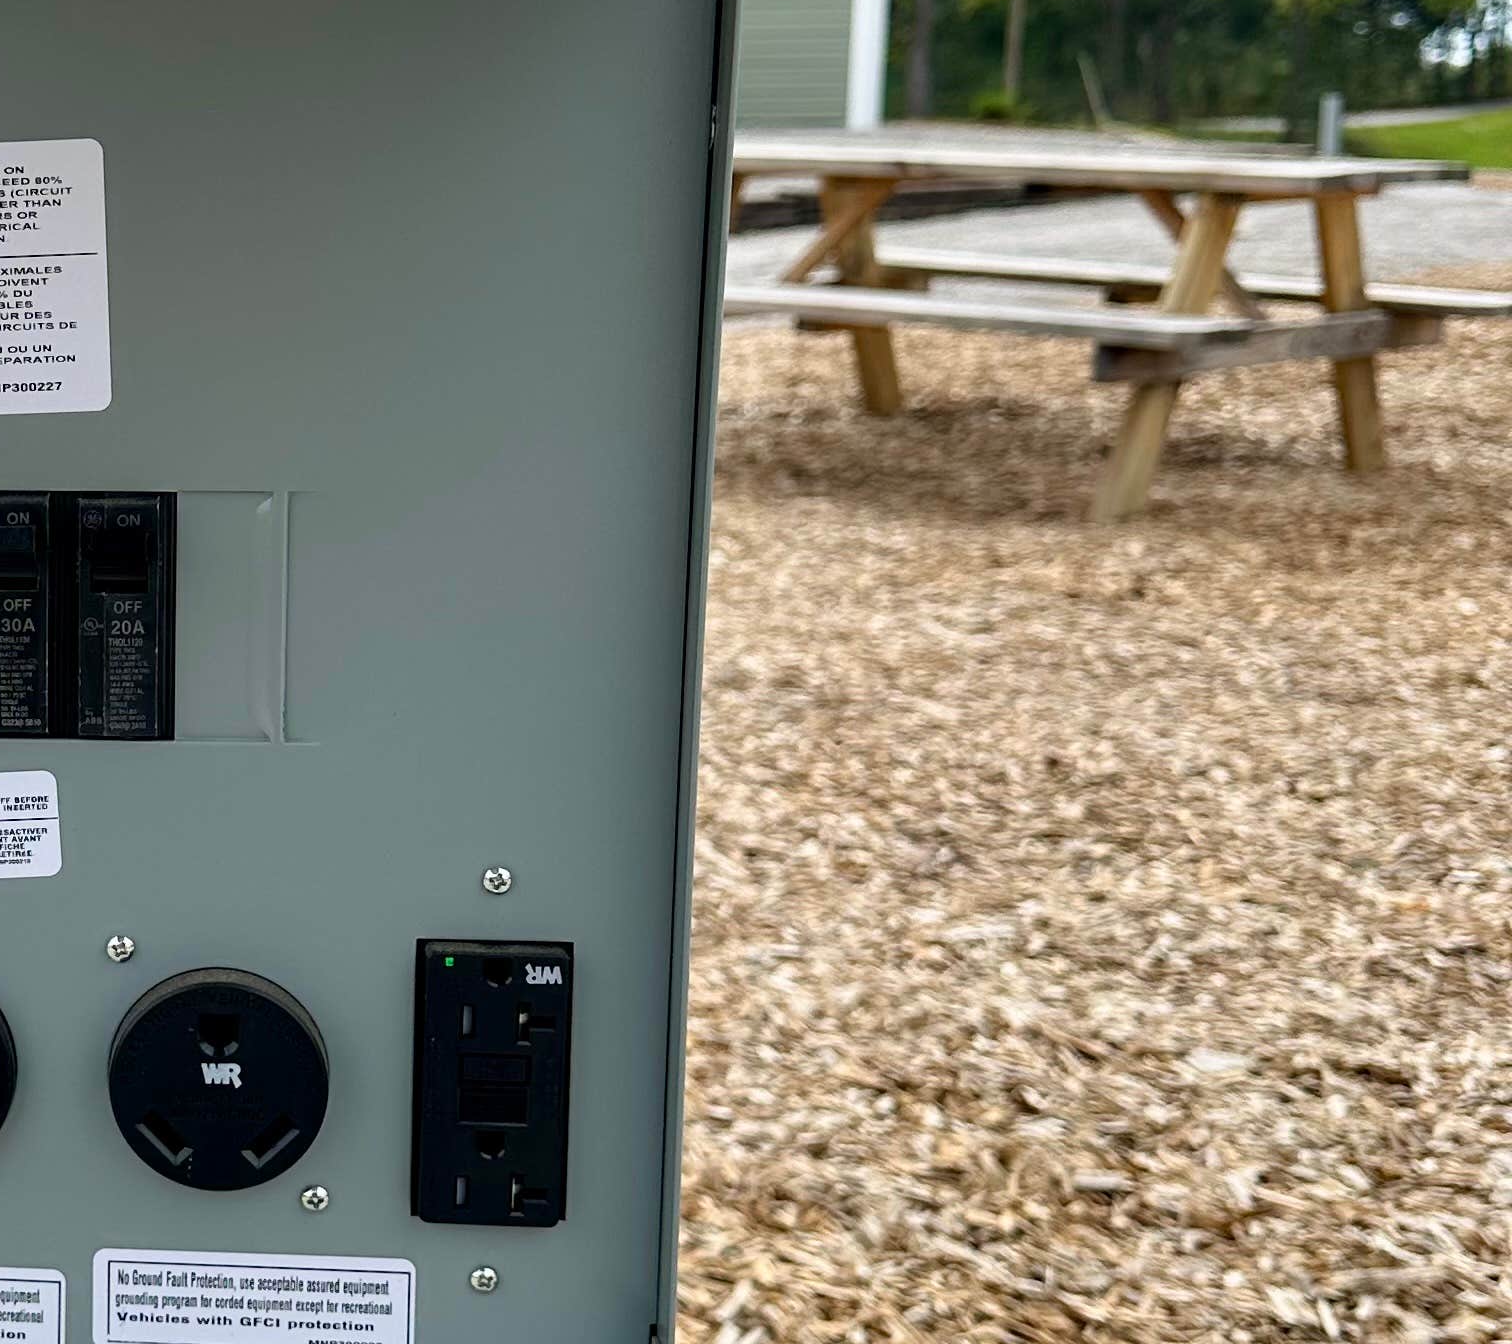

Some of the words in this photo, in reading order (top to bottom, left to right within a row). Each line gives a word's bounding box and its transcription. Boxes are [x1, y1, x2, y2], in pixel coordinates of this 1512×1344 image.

[4, 166, 24, 174] ON
[35, 176, 62, 184] 80%
[11, 187, 72, 198] (CIRCUIT
[23, 199, 61, 207] THAN
[17, 211, 38, 219] OR
[6, 512, 30, 524] ON
[116, 514, 141, 526] ON
[2, 599, 32, 612] OFF
[113, 601, 142, 614] OFF
[0, 618, 36, 633] 30A
[111, 620, 145, 634] 20A
[525, 963, 563, 986] WR
[200, 1062, 244, 1089] WR
[118, 1270, 130, 1285] No
[132, 1270, 163, 1286] Ground
[166, 1271, 188, 1287] Fault
[191, 1272, 236, 1290] Protection,
[240, 1278, 255, 1290] use
[258, 1277, 304, 1293] acceptable
[307, 1279, 340, 1294] assured
[343, 1281, 389, 1297] equipment
[116, 1293, 158, 1308] grounding
[162, 1296, 198, 1310] program
[200, 1295, 212, 1308] for
[215, 1296, 244, 1309] corded
[247, 1299, 292, 1313] equipment
[296, 1300, 324, 1315] except
[327, 1300, 339, 1313] for
[342, 1302, 392, 1315] recreational
[117, 1312, 190, 1324] Vehicles
[197, 1316, 232, 1325] with
[240, 1317, 280, 1327] GFCI
[288, 1321, 374, 1331] protection
